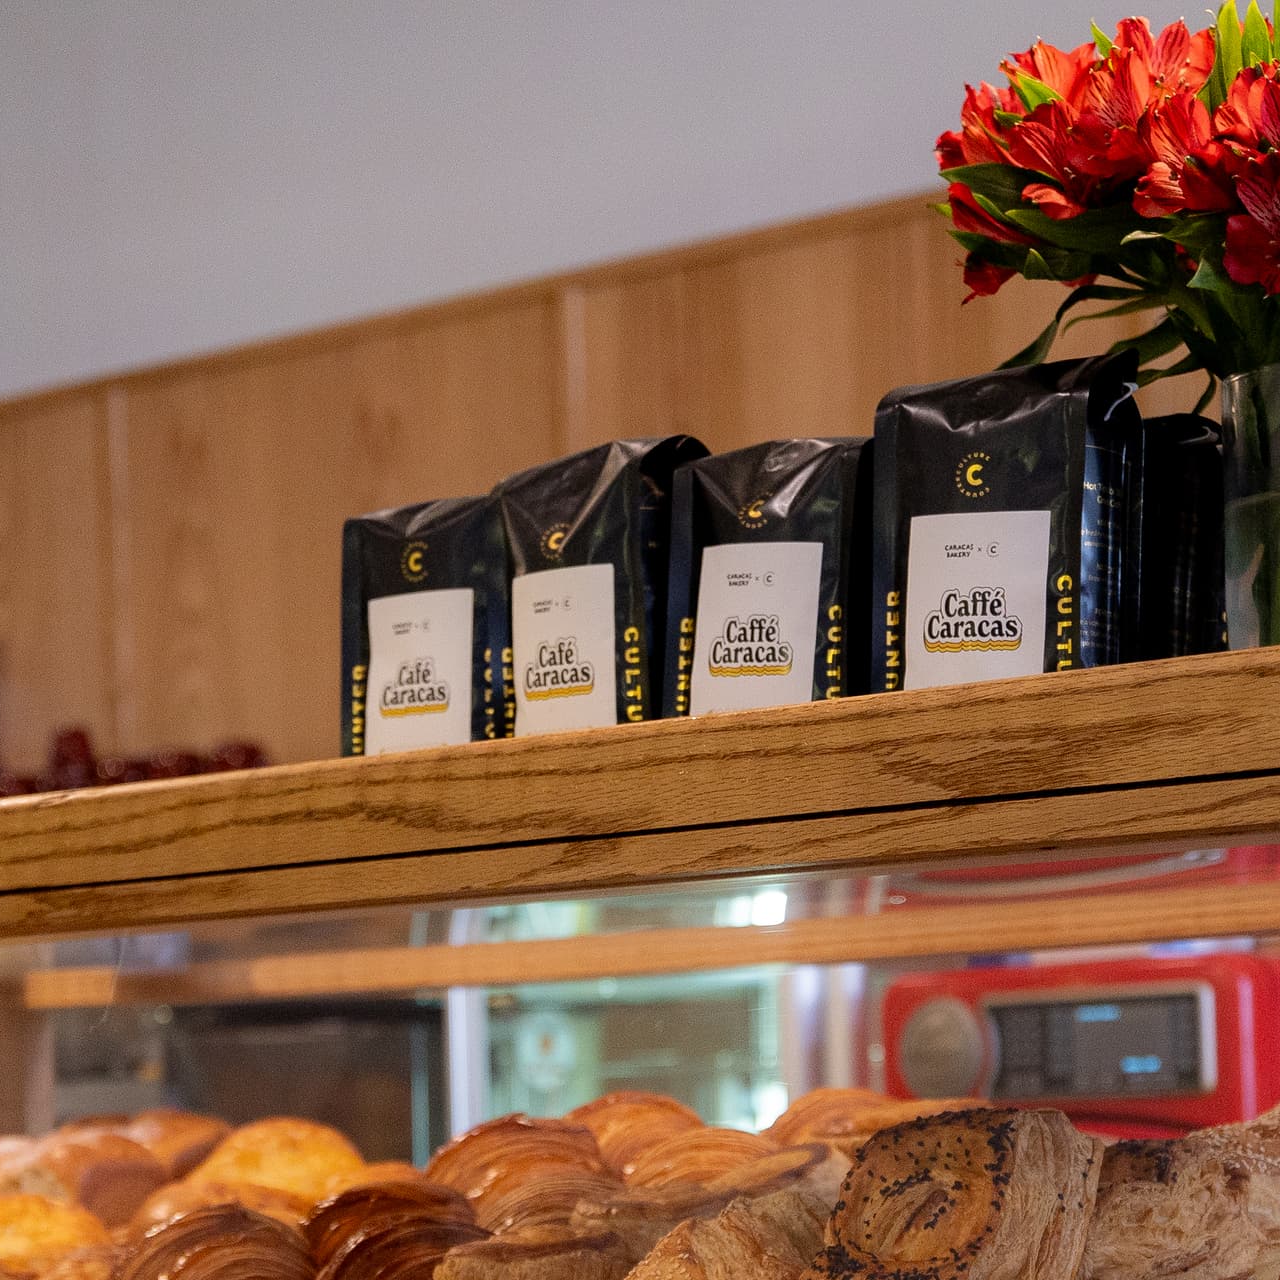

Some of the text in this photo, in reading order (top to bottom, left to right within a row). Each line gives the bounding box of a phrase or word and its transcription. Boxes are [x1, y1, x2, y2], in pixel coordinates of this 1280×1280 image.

[966, 463, 983, 485] C
[944, 543, 974, 552] CARACAS
[944, 590, 1004, 617] Caffé
[726, 616, 779, 644] Caffé
[927, 615, 1018, 639] Caracas
[712, 641, 790, 665] Caracas
[526, 666, 591, 689] Caracas
[383, 686, 446, 706] Caracas
